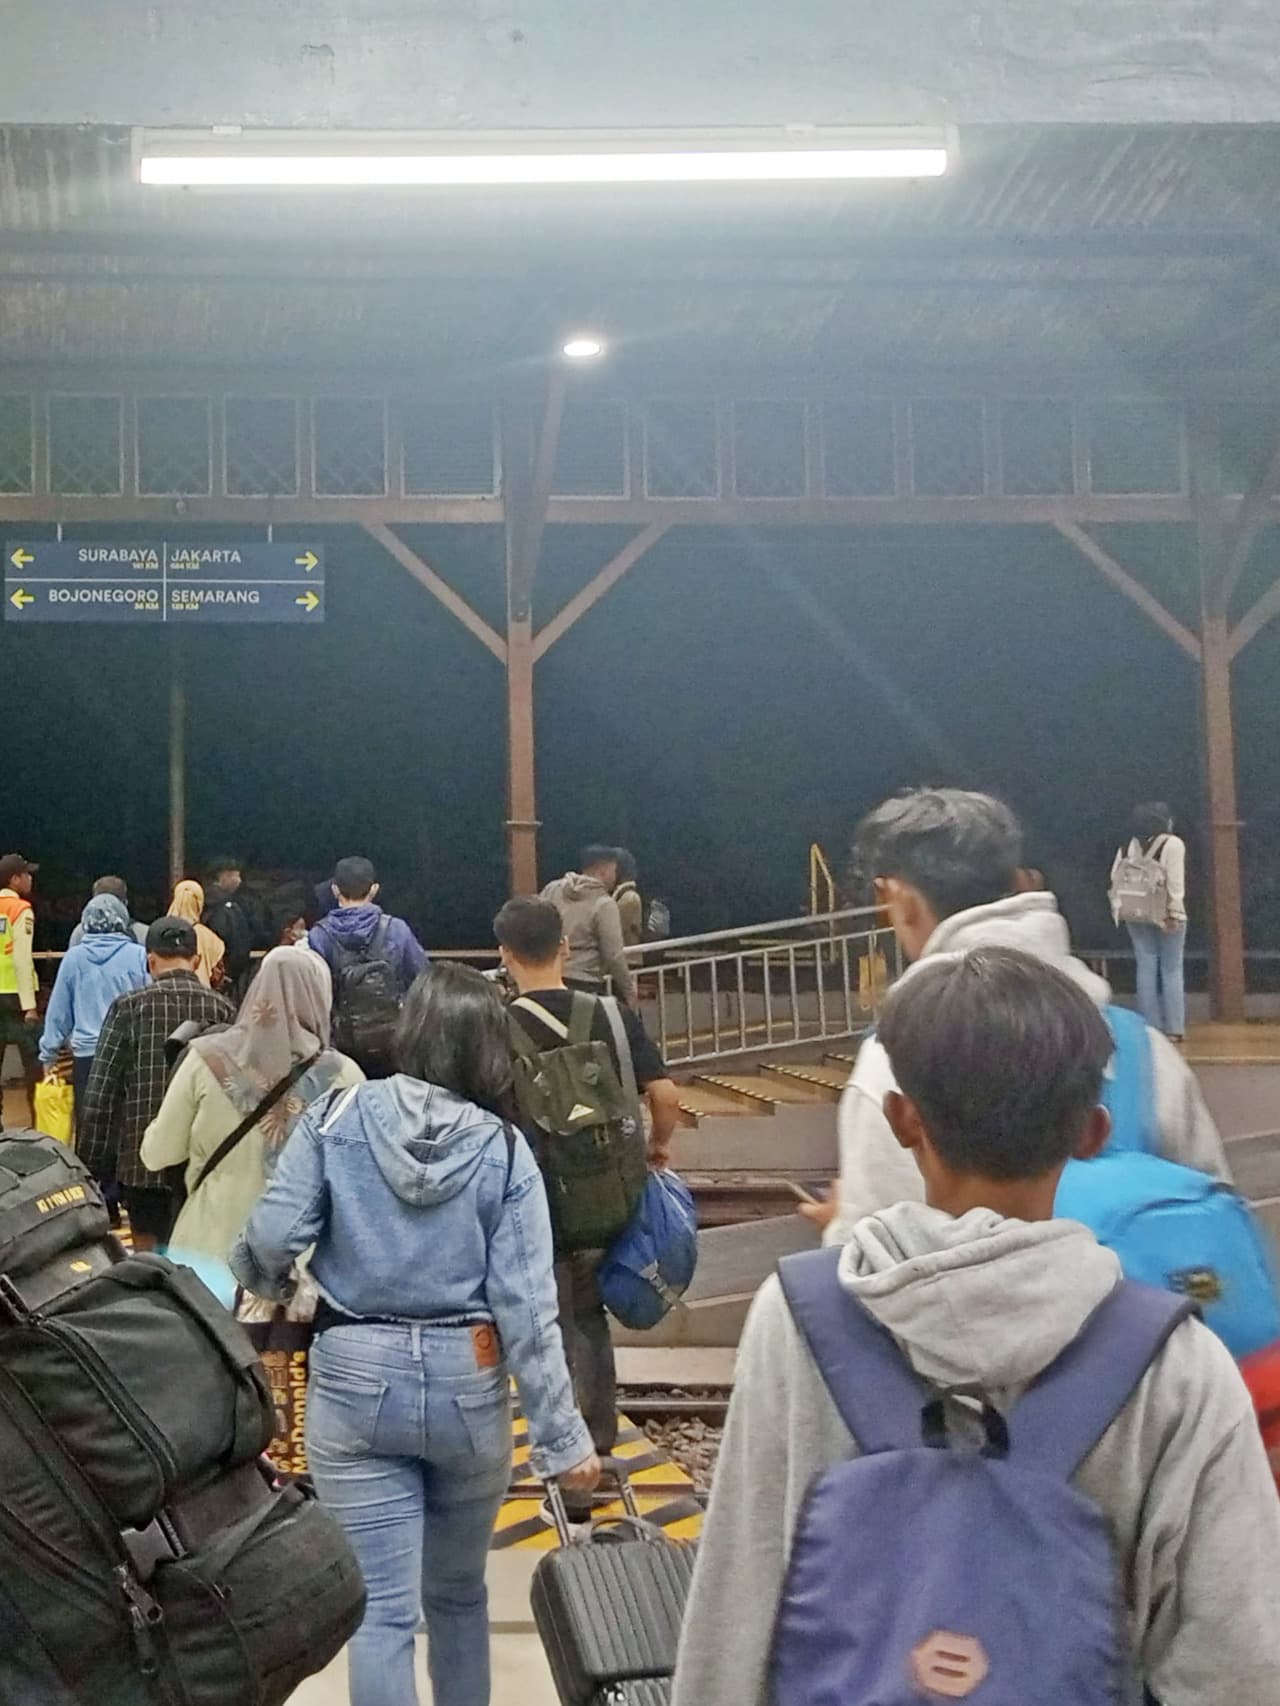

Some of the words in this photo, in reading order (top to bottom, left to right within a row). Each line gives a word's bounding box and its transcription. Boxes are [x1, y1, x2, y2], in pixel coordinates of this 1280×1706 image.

[78, 548, 159, 562] SURABAYA
[171, 549, 242, 563] JAKARTA
[49, 589, 159, 603] BOJONEGORO
[171, 590, 260, 604] SEMARANG
[289, 1351, 308, 1474] McDonald's
